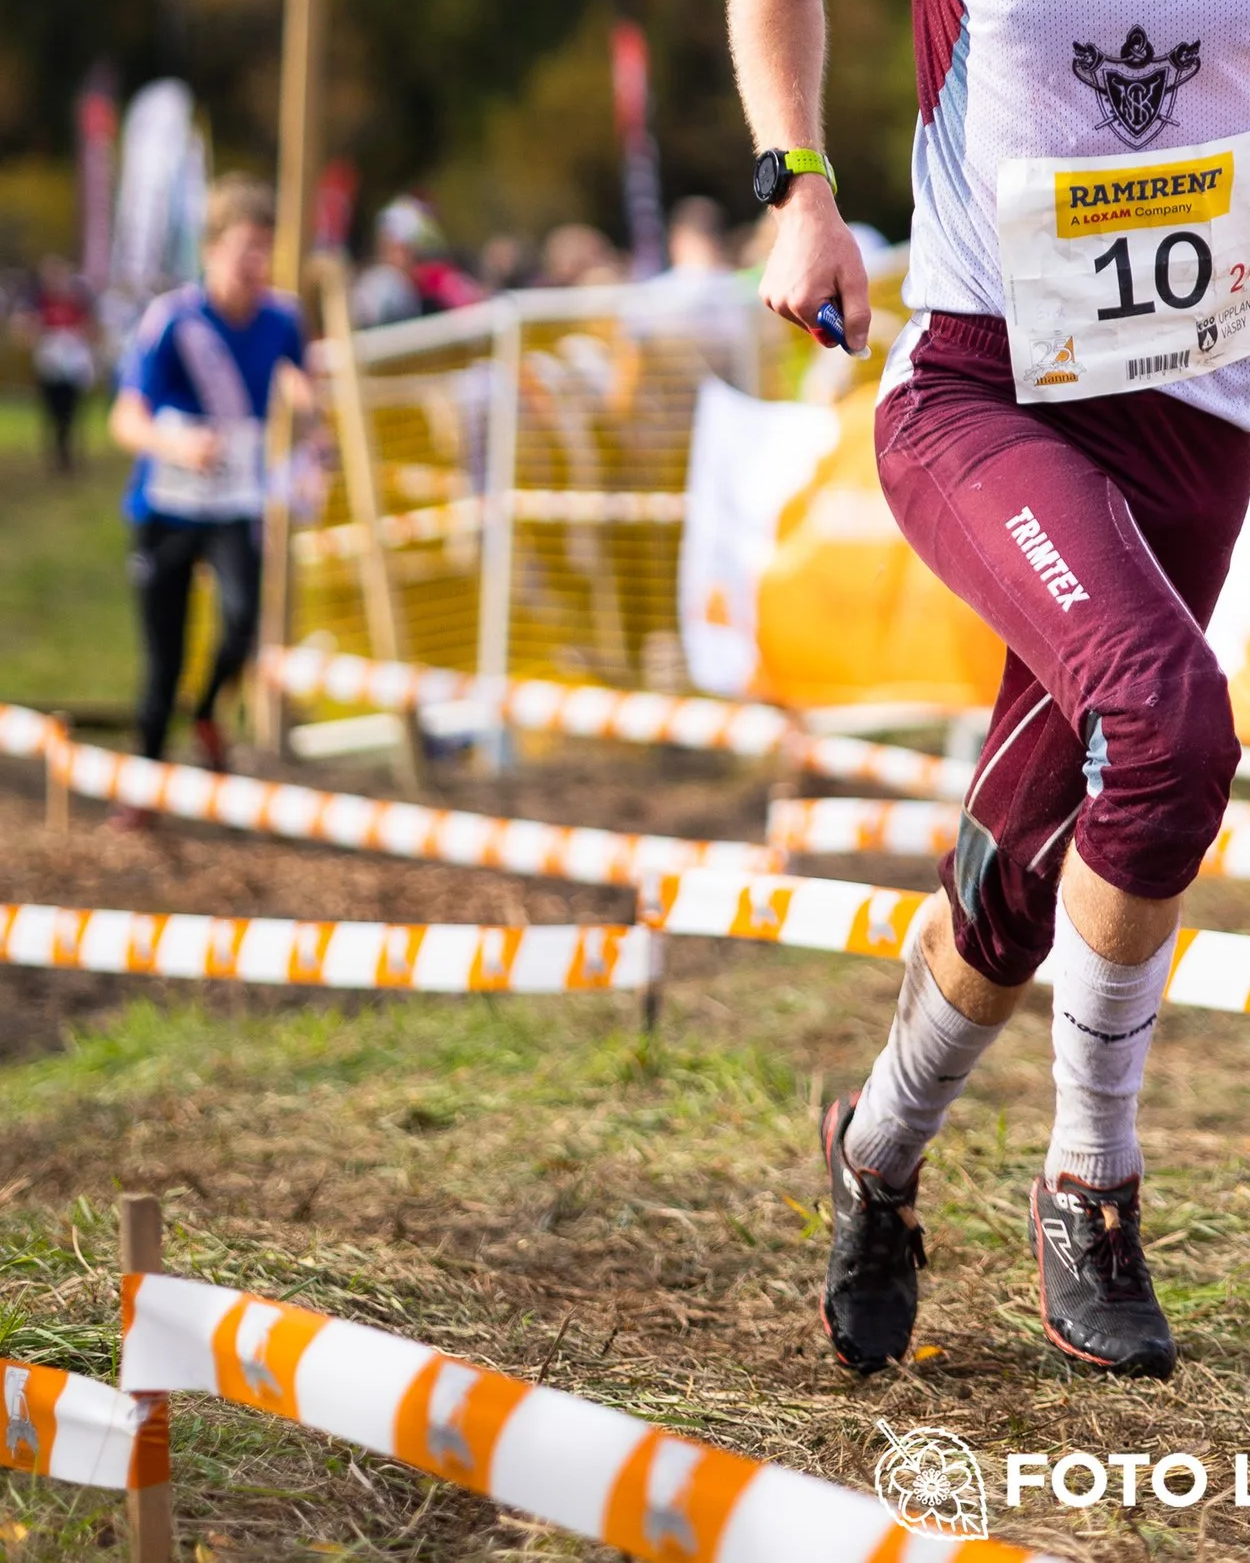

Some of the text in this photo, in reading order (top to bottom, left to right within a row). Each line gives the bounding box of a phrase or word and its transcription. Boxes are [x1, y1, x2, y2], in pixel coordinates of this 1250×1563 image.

[1069, 167, 1223, 209] RAMIRENT
[1070, 202, 1193, 226] A LOXAM Company
[1094, 231, 1212, 321] 10
[1005, 505, 1091, 613] TRIMTEX
